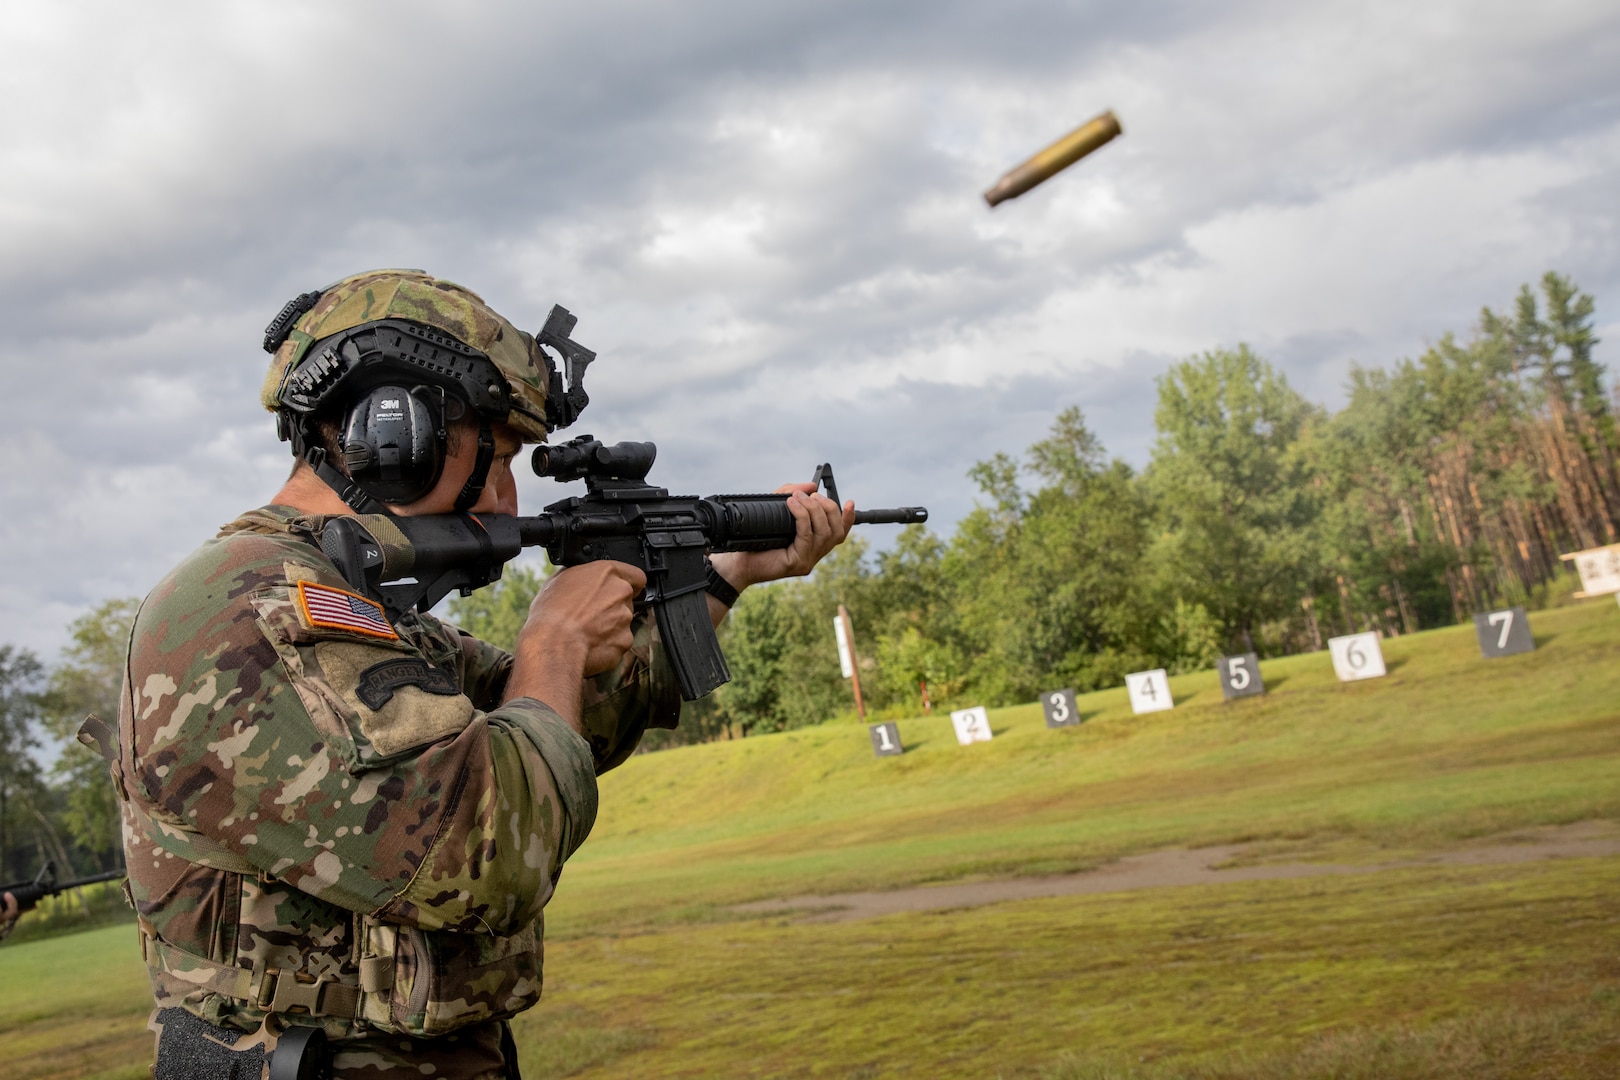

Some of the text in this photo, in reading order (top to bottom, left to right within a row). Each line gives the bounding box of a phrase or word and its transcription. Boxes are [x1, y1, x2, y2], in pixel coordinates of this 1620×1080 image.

[380, 399, 400, 410] 3M
[1488, 610, 1514, 648] 7
[1346, 639, 1367, 670] 6
[369, 665, 425, 687] RANGER
[1228, 657, 1250, 689] 5
[1141, 675, 1157, 702] 4
[1050, 692, 1069, 721] 3
[963, 712, 978, 733] 2
[875, 724, 894, 751] 1
